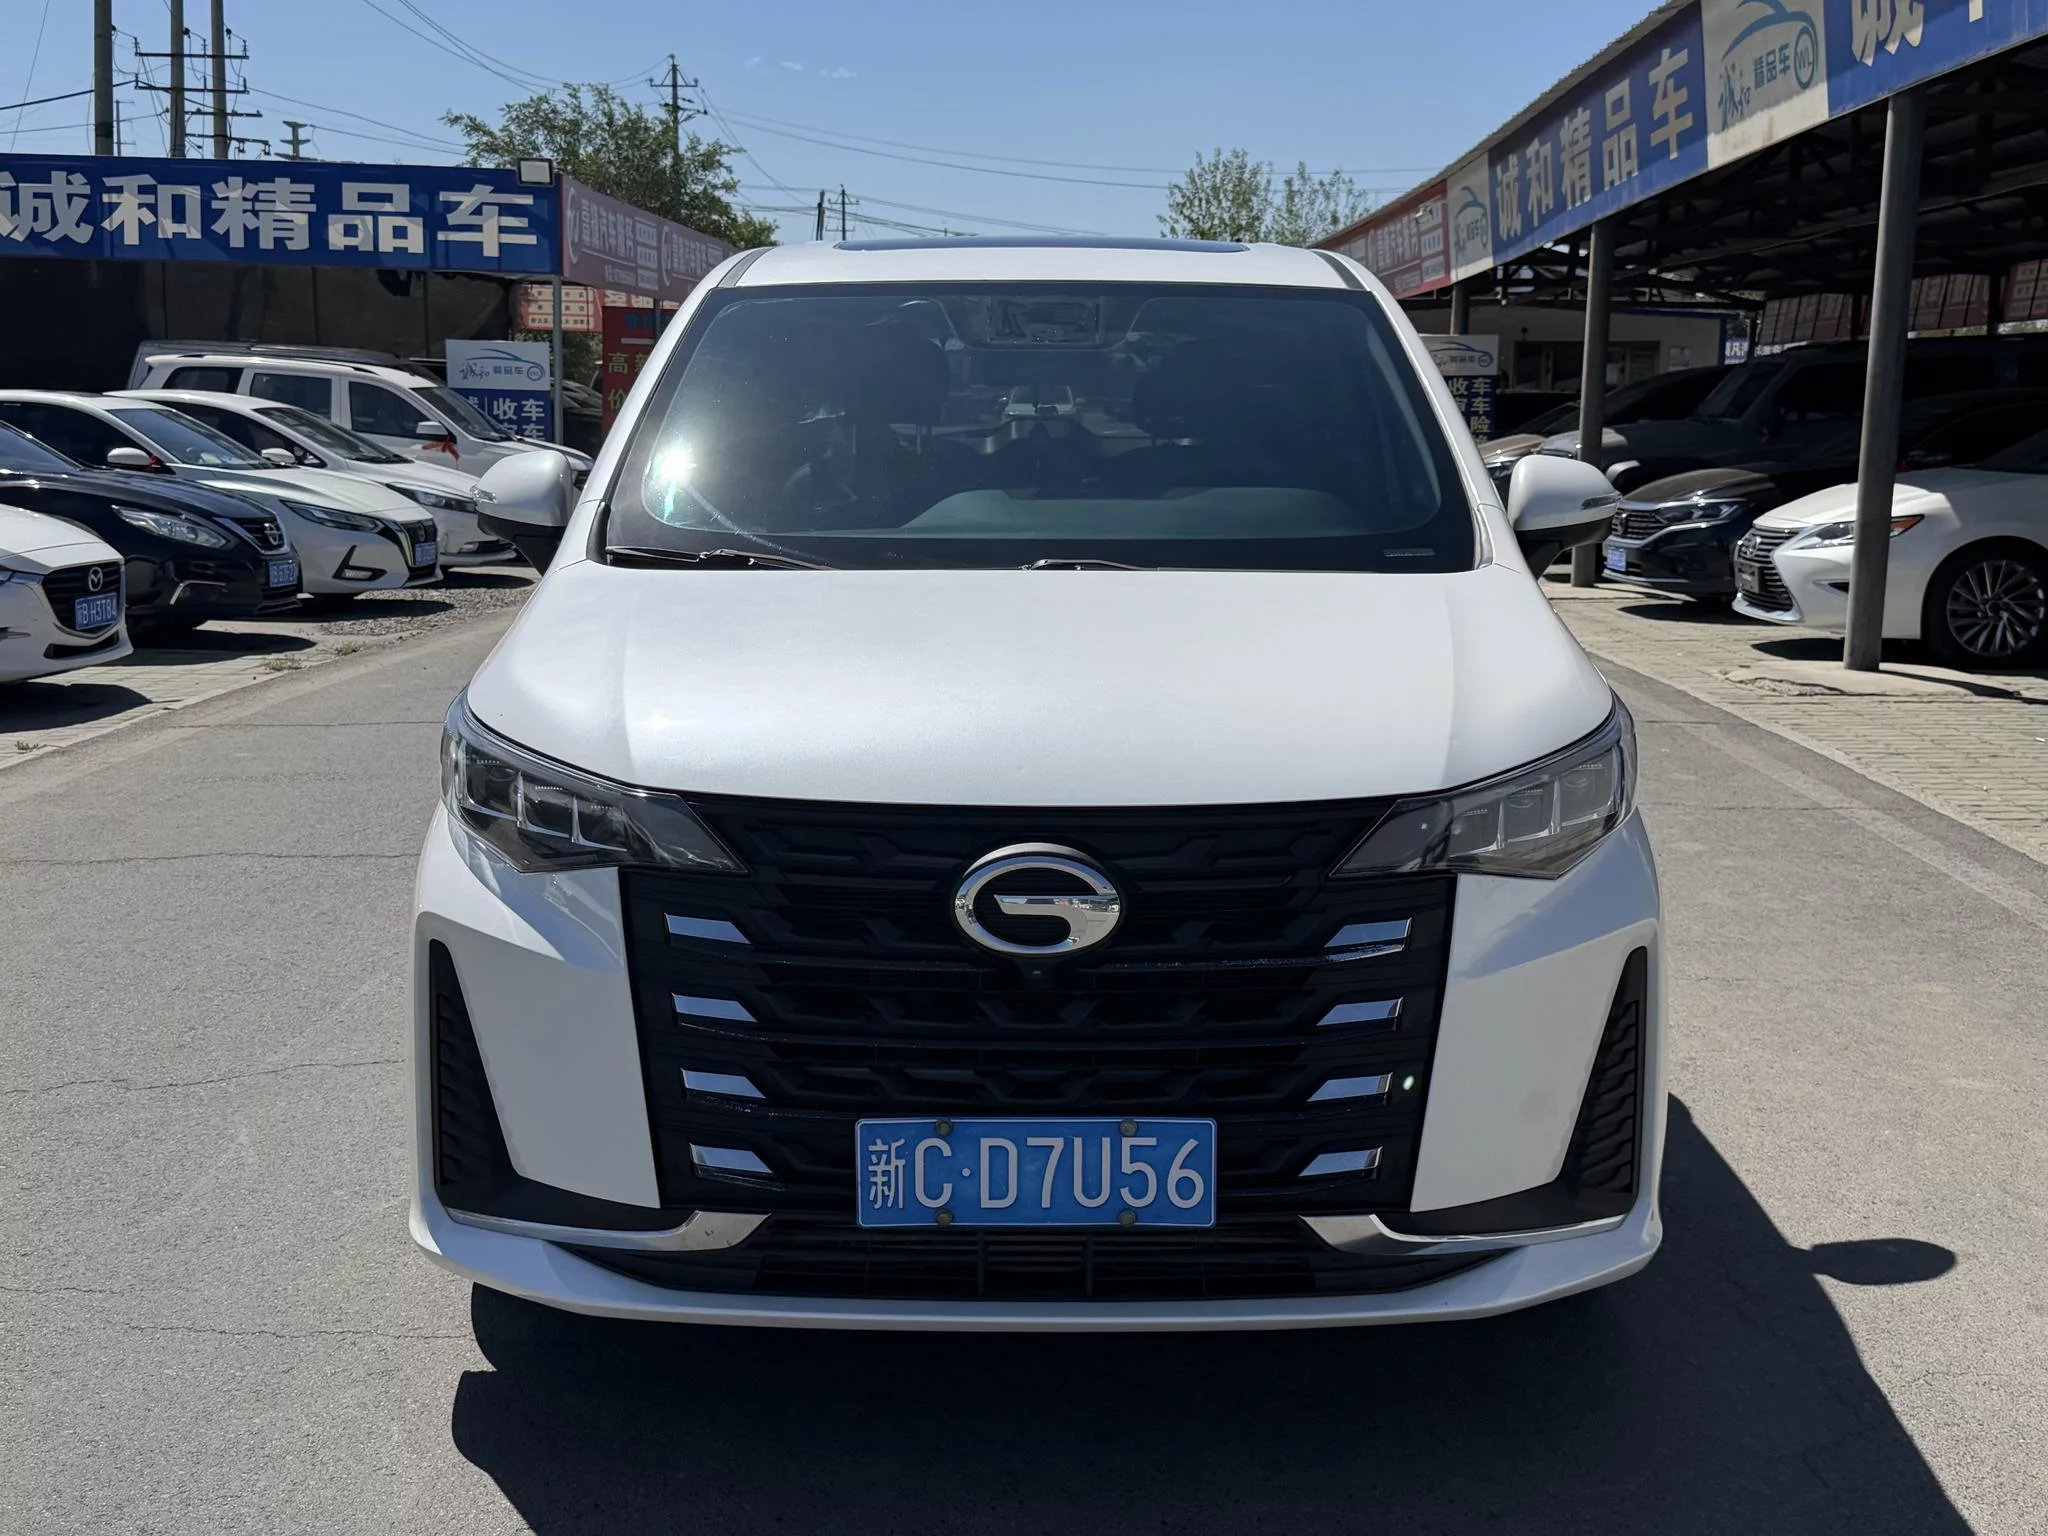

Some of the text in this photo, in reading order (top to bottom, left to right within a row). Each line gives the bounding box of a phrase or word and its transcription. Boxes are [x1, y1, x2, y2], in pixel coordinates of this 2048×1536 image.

[1754, 42, 1791, 91] 精品车
[1496, 48, 1694, 242] 诚和精品车
[0, 170, 538, 258] 诚和精品车
[493, 397, 546, 421] 收车
[1449, 377, 1492, 395] 收车
[867, 1136, 1206, 1210] 新C·D7U56
